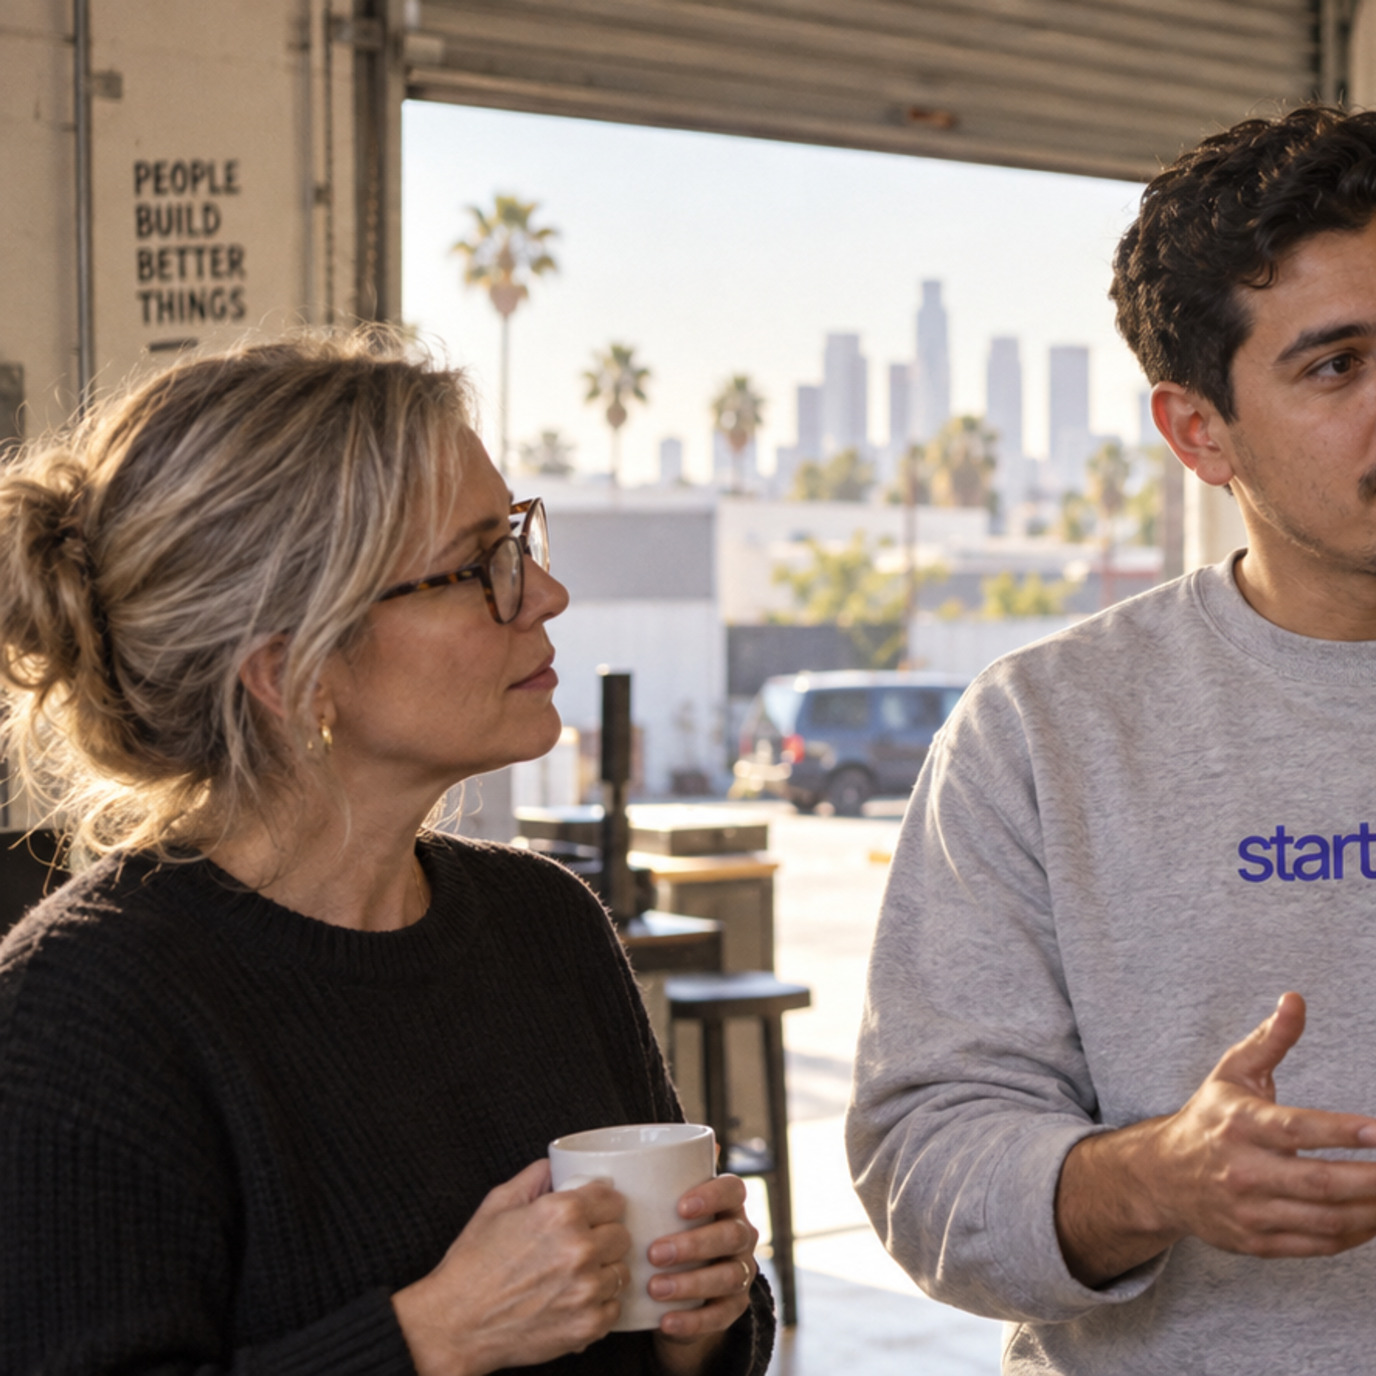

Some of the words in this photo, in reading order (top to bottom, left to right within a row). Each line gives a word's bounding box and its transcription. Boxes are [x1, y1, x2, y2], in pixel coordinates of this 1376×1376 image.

[134, 159, 240, 196] PEOPLE
[136, 202, 221, 239] BUILD
[137, 244, 245, 282] BETTER
[137, 287, 246, 323] THINGS
